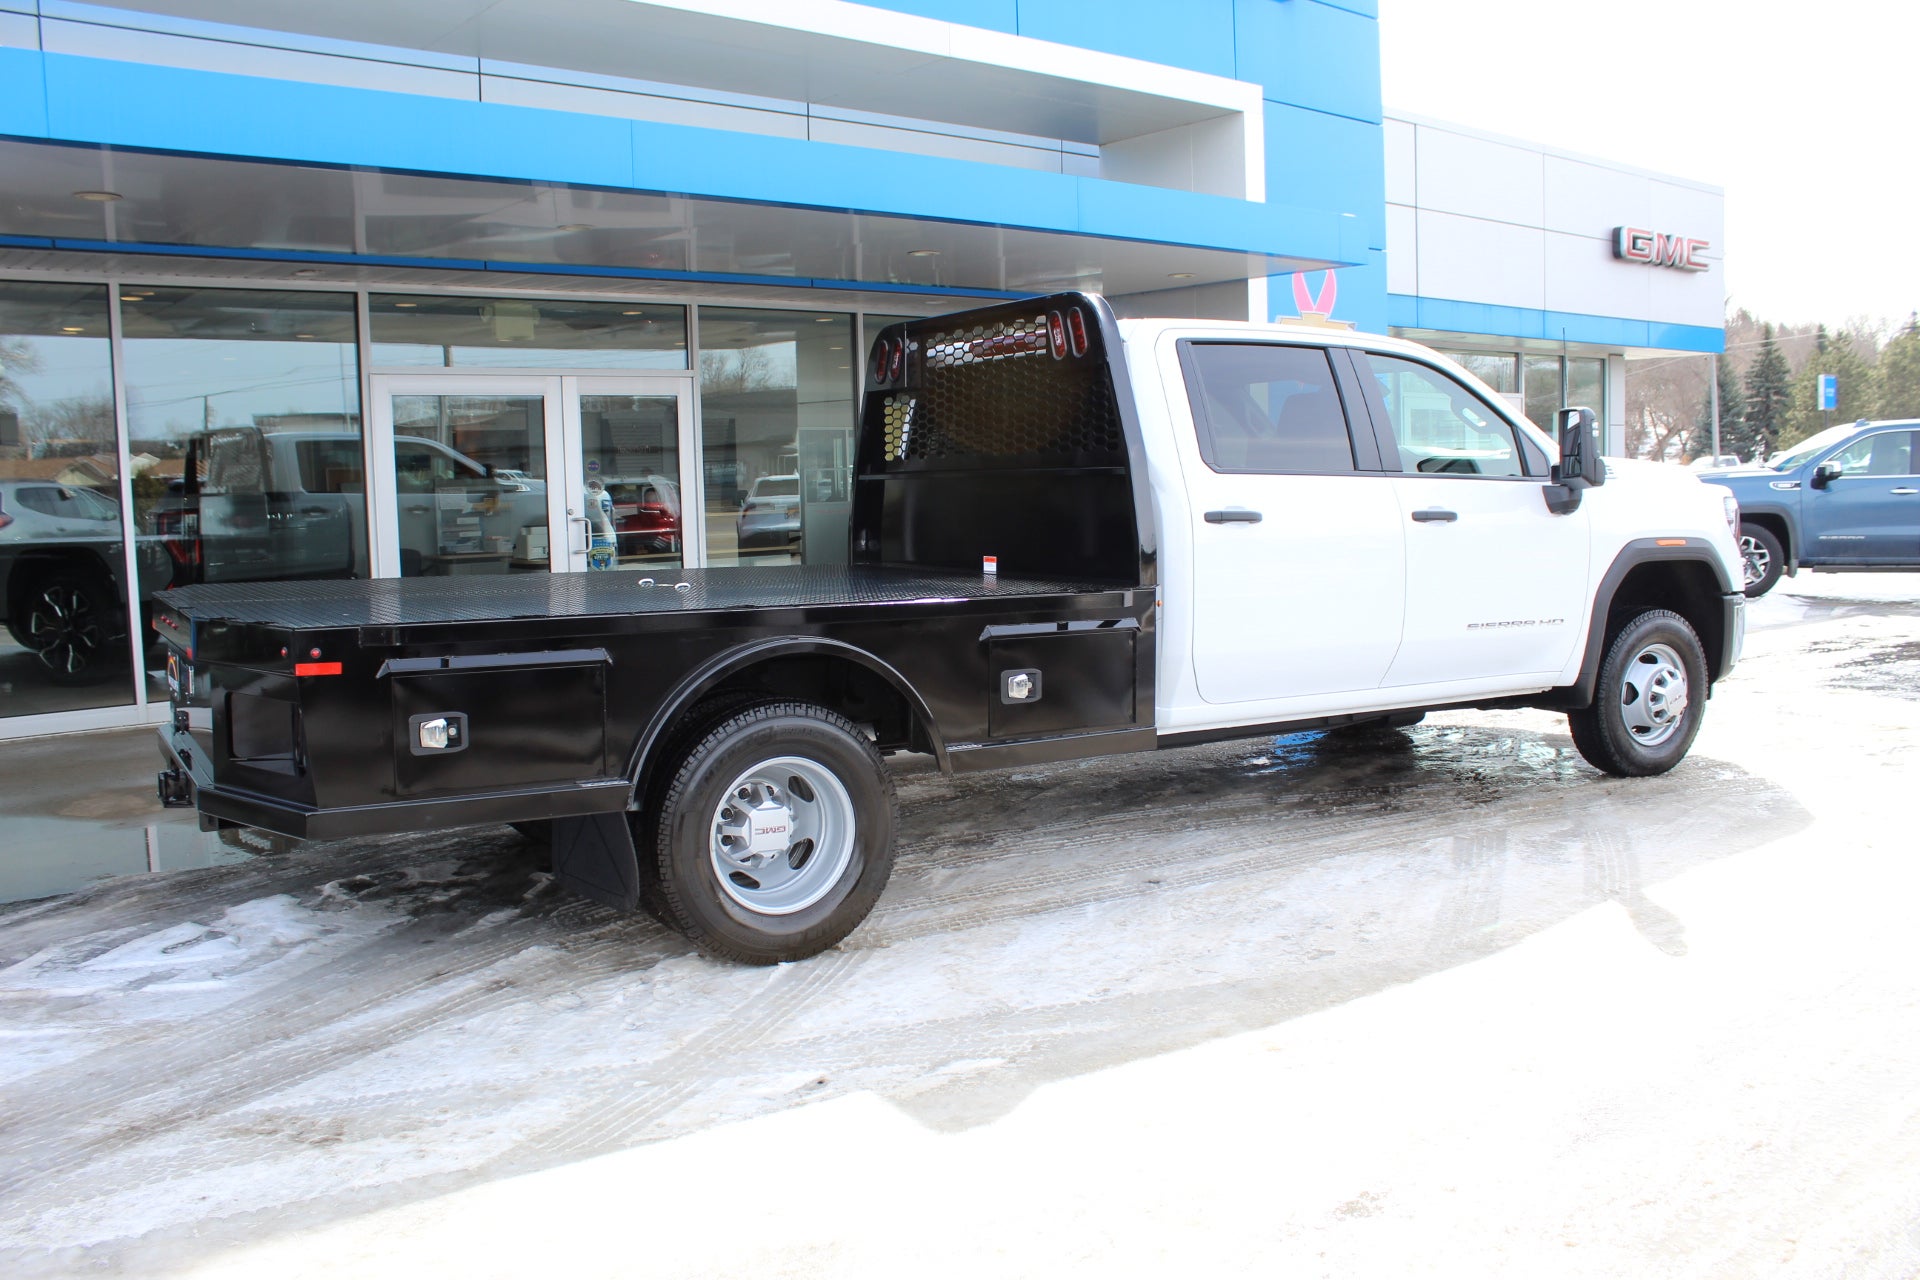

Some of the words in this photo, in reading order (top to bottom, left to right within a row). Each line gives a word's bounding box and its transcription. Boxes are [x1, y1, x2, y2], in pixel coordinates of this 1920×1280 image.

[1614, 226, 1711, 272] GMC
[1466, 619, 1536, 631] SIERRA
[754, 826, 786, 835] GMC
